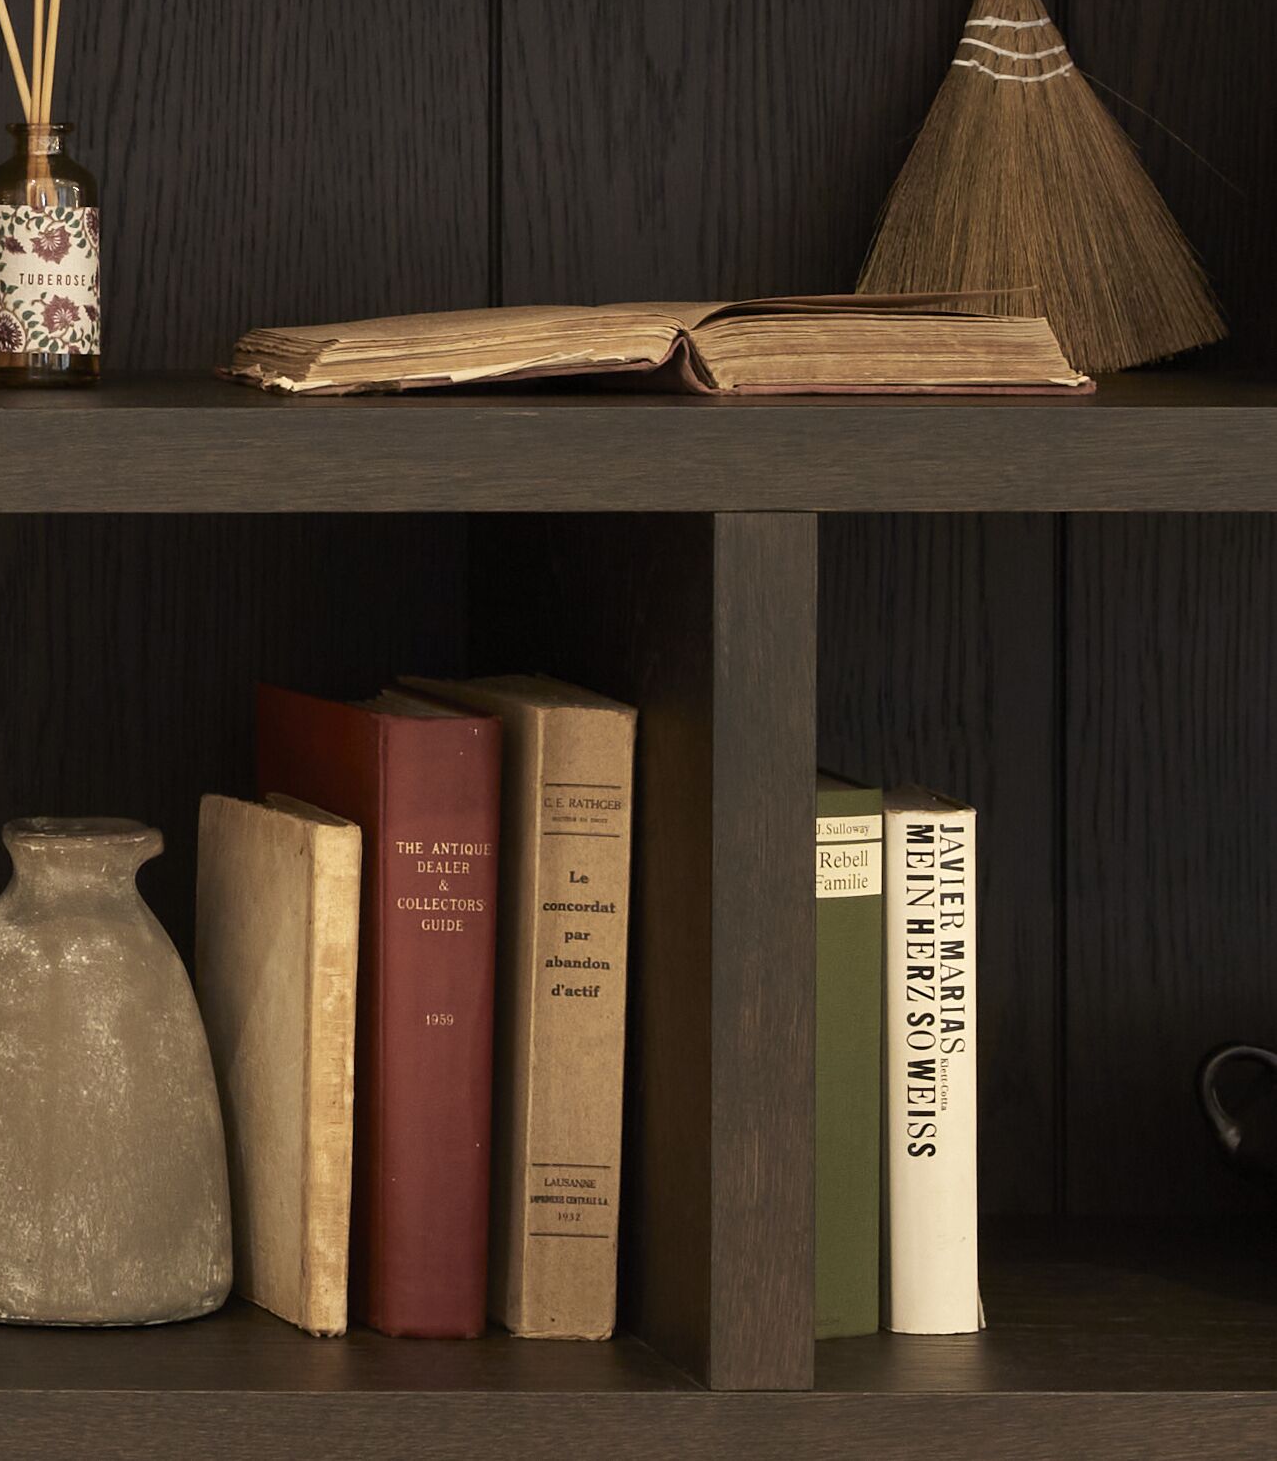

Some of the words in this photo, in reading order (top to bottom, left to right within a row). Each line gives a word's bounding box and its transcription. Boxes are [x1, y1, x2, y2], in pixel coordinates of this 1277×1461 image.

[19, 273, 86, 287] TUBEROSE
[826, 823, 870, 836] Sulloway
[396, 841, 423, 854] THE
[432, 842, 492, 856] ANTIQUE
[819, 850, 868, 869] Rebell
[906, 824, 935, 908] MEIN
[417, 860, 470, 874] DEALER
[569, 871, 589, 884] Le
[939, 823, 965, 930] JAVIER
[438, 879, 449, 891] &
[543, 901, 616, 914] concordat
[421, 919, 464, 931] GUIDE
[564, 930, 591, 943] par
[545, 956, 610, 970] abandon
[906, 919, 936, 1002] HERZ
[551, 984, 600, 998] d'actif
[939, 940, 965, 1054] MARIAS
[426, 1014, 454, 1026] 1959
[906, 1012, 936, 1051] SO
[940, 1058, 949, 1112] Klett-Cotta
[906, 1058, 937, 1157] WEISS
[544, 1178, 596, 1189] LAUSANNE
